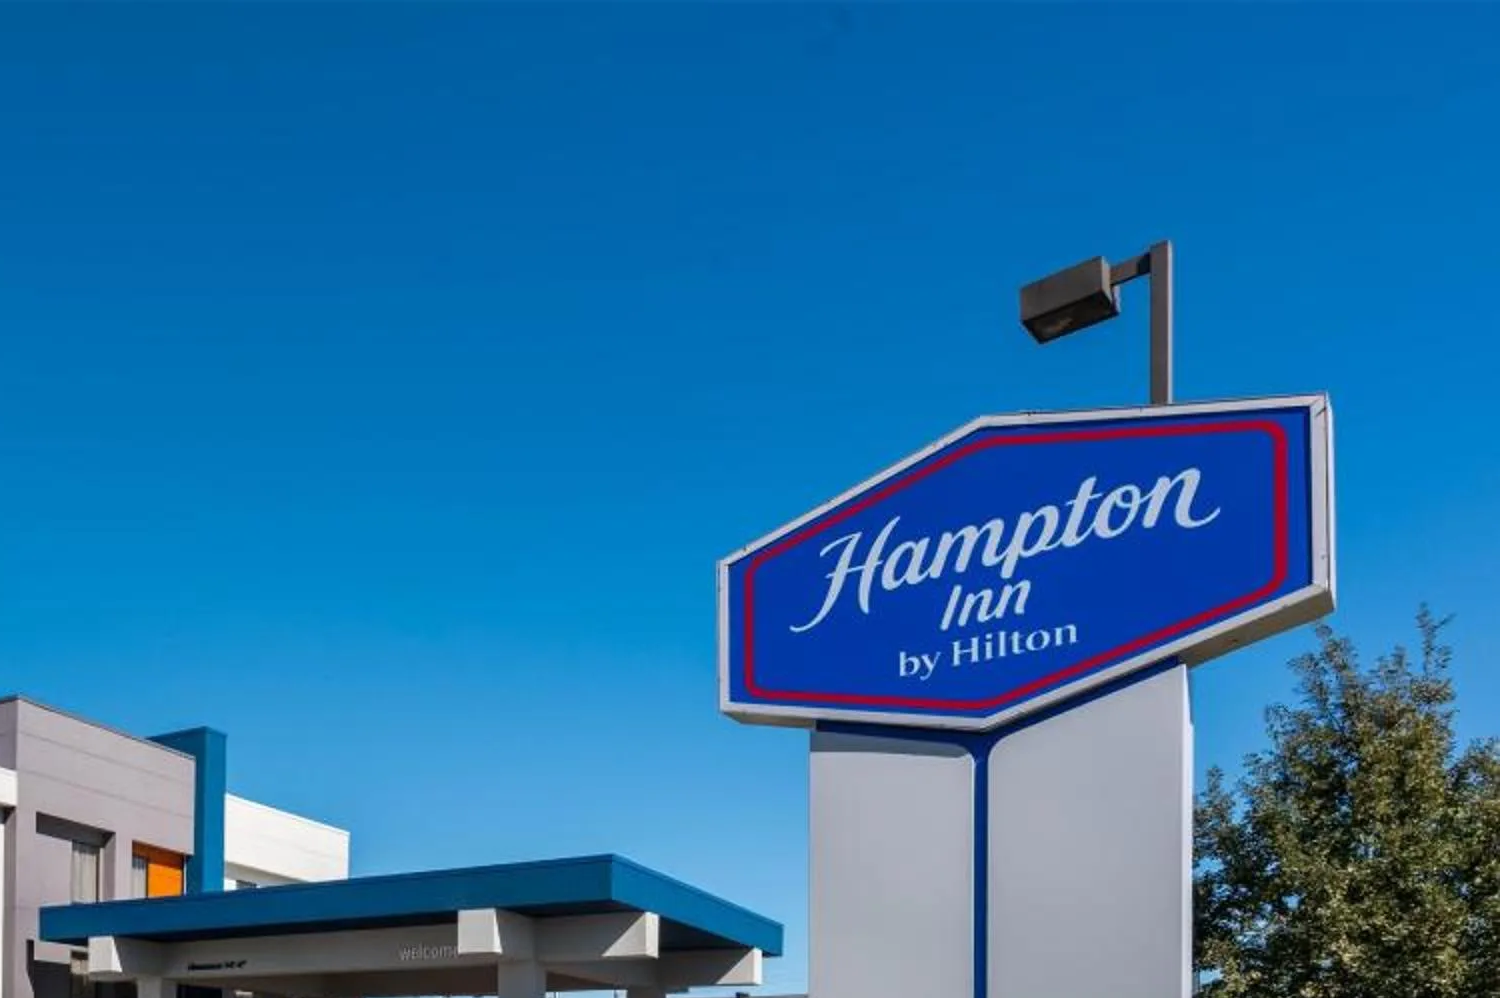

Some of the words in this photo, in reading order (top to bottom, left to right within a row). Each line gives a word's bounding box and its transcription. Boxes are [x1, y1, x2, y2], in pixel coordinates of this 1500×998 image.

[790, 467, 1220, 632] Hampton
[939, 580, 1032, 632] Inn
[899, 651, 941, 681] by
[951, 623, 1079, 667] Hilton
